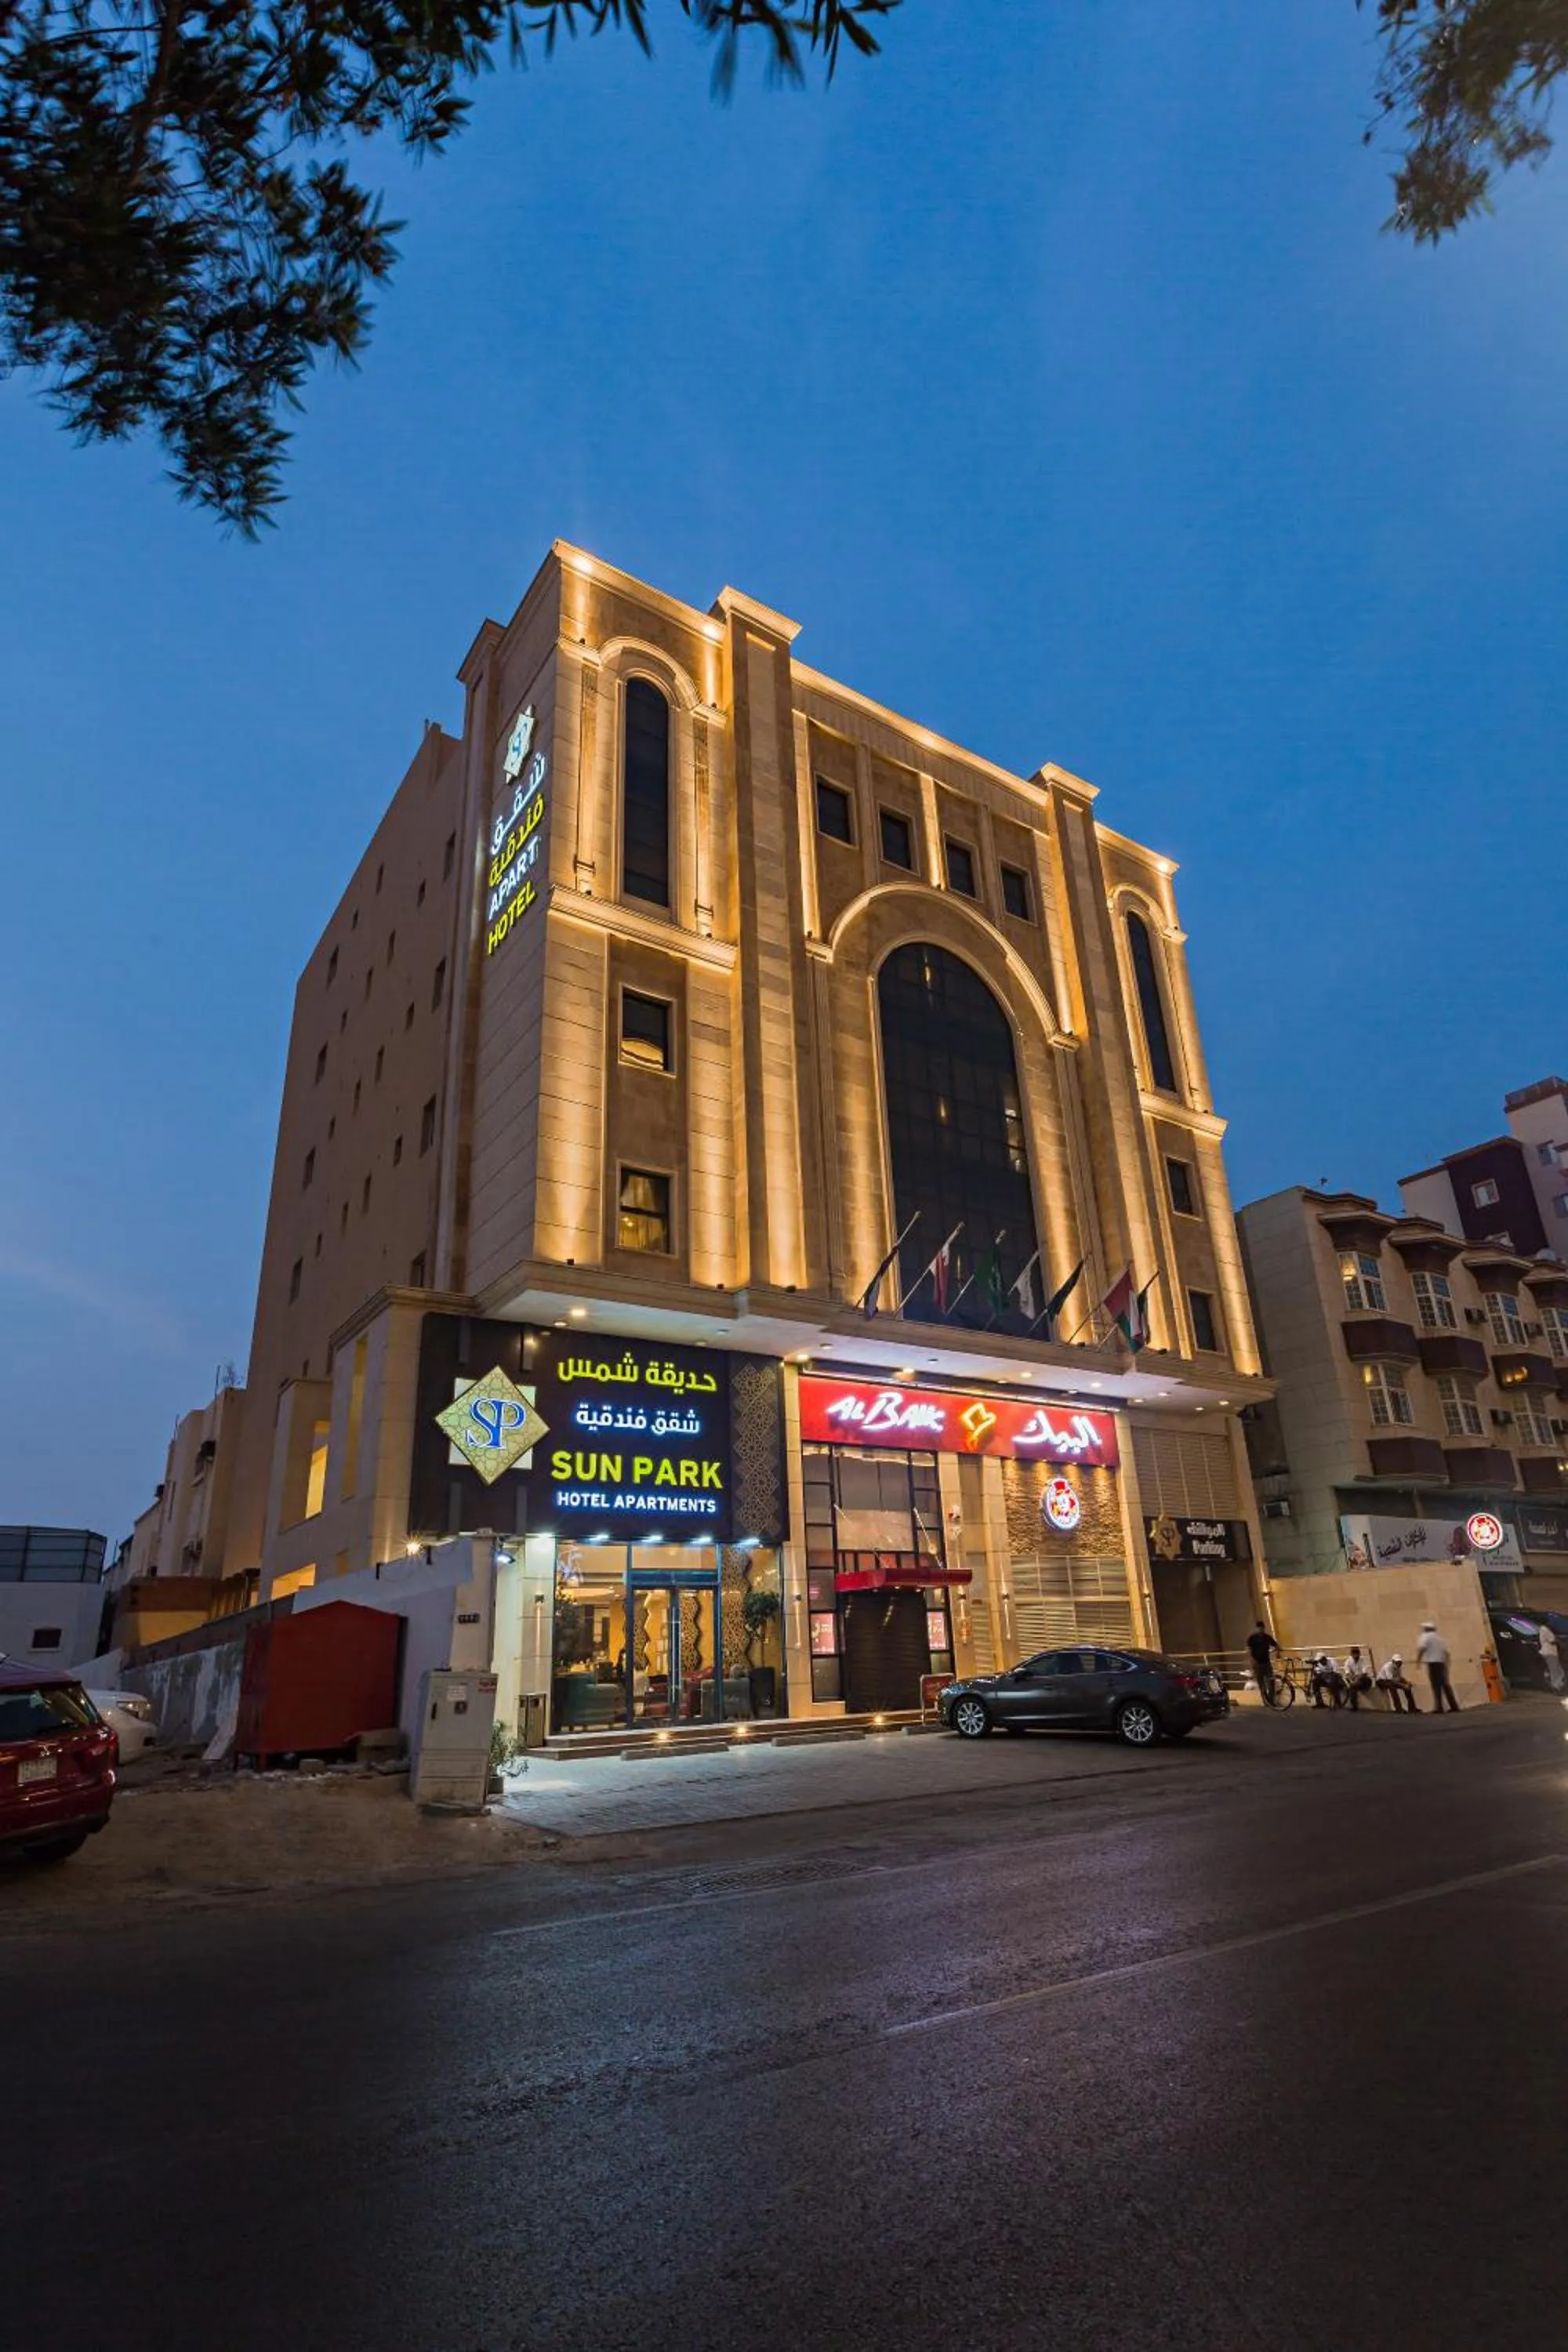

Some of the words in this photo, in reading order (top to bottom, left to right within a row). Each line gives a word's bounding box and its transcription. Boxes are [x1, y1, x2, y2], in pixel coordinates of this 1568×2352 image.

[488, 835, 539, 920] APART
[488, 880, 536, 954] HOTEL
[557, 1352, 639, 1382] شمس
[644, 1359, 717, 1395] حديقة
[575, 1403, 646, 1432] فندقية
[650, 1408, 701, 1436] شقق
[1012, 1410, 1103, 1454] البيك
[550, 1450, 622, 1483] SUN
[631, 1456, 724, 1490] PARK
[557, 1491, 610, 1508] HOTEL
[613, 1494, 717, 1513] APARTMENTS
